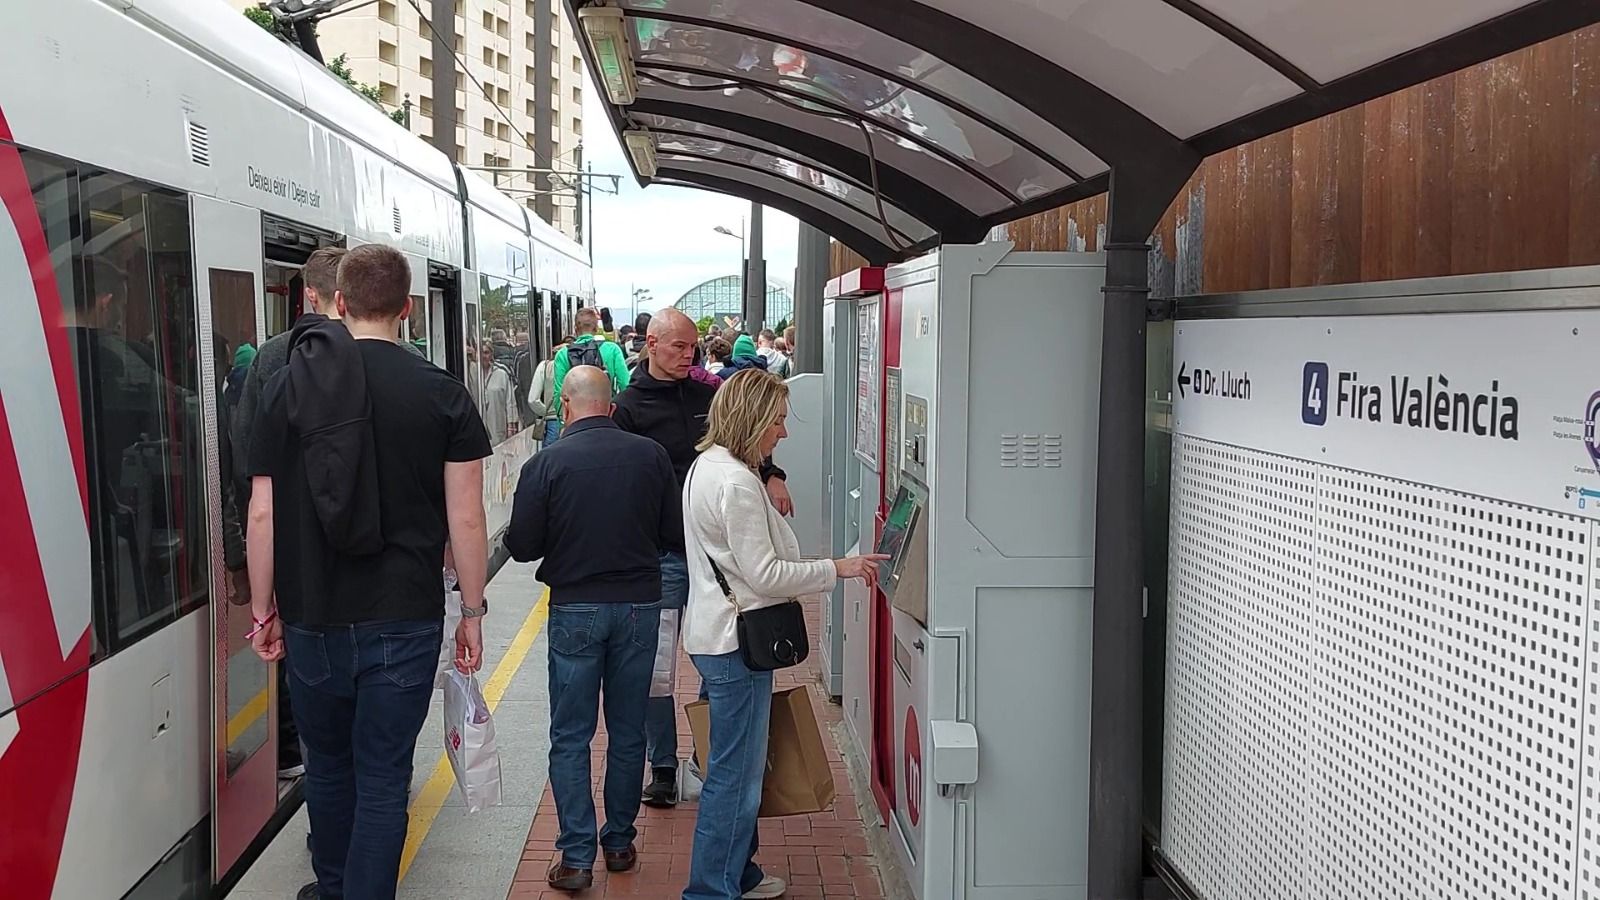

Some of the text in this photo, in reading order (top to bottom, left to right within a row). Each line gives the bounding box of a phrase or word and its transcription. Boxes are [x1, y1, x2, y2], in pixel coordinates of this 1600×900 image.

[248, 165, 272, 193] Deixeu
[274, 176, 286, 197] eixir
[291, 181, 308, 208] Dejen
[309, 189, 321, 208] salir
[1204, 369, 1218, 396] Dr.
[1221, 370, 1251, 400] Lluch
[1336, 371, 1382, 423] Fira
[1391, 373, 1519, 441] València
